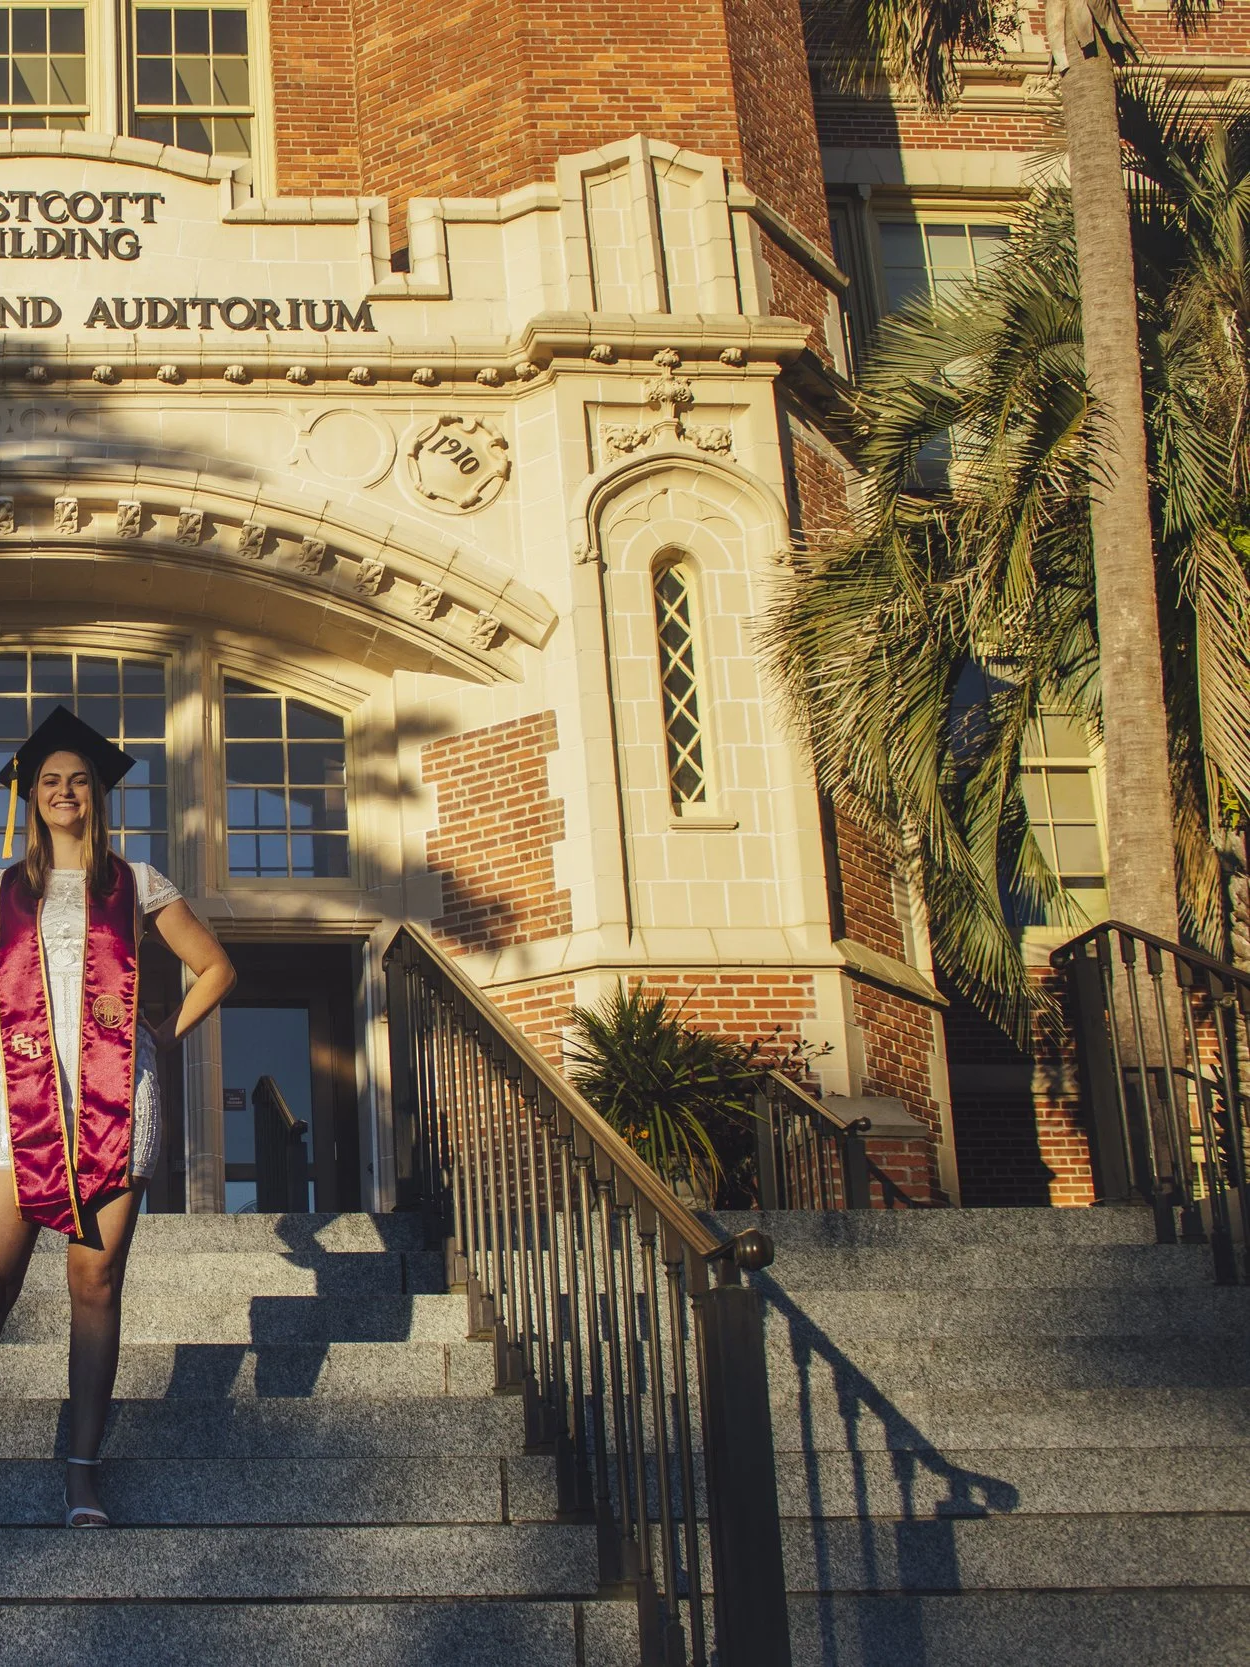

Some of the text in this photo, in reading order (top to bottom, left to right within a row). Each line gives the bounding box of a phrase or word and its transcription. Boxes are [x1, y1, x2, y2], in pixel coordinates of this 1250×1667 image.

[83, 296, 378, 332] AUDITORIUM
[428, 435, 480, 475] 1910
[12, 1033, 42, 1060] FSU
